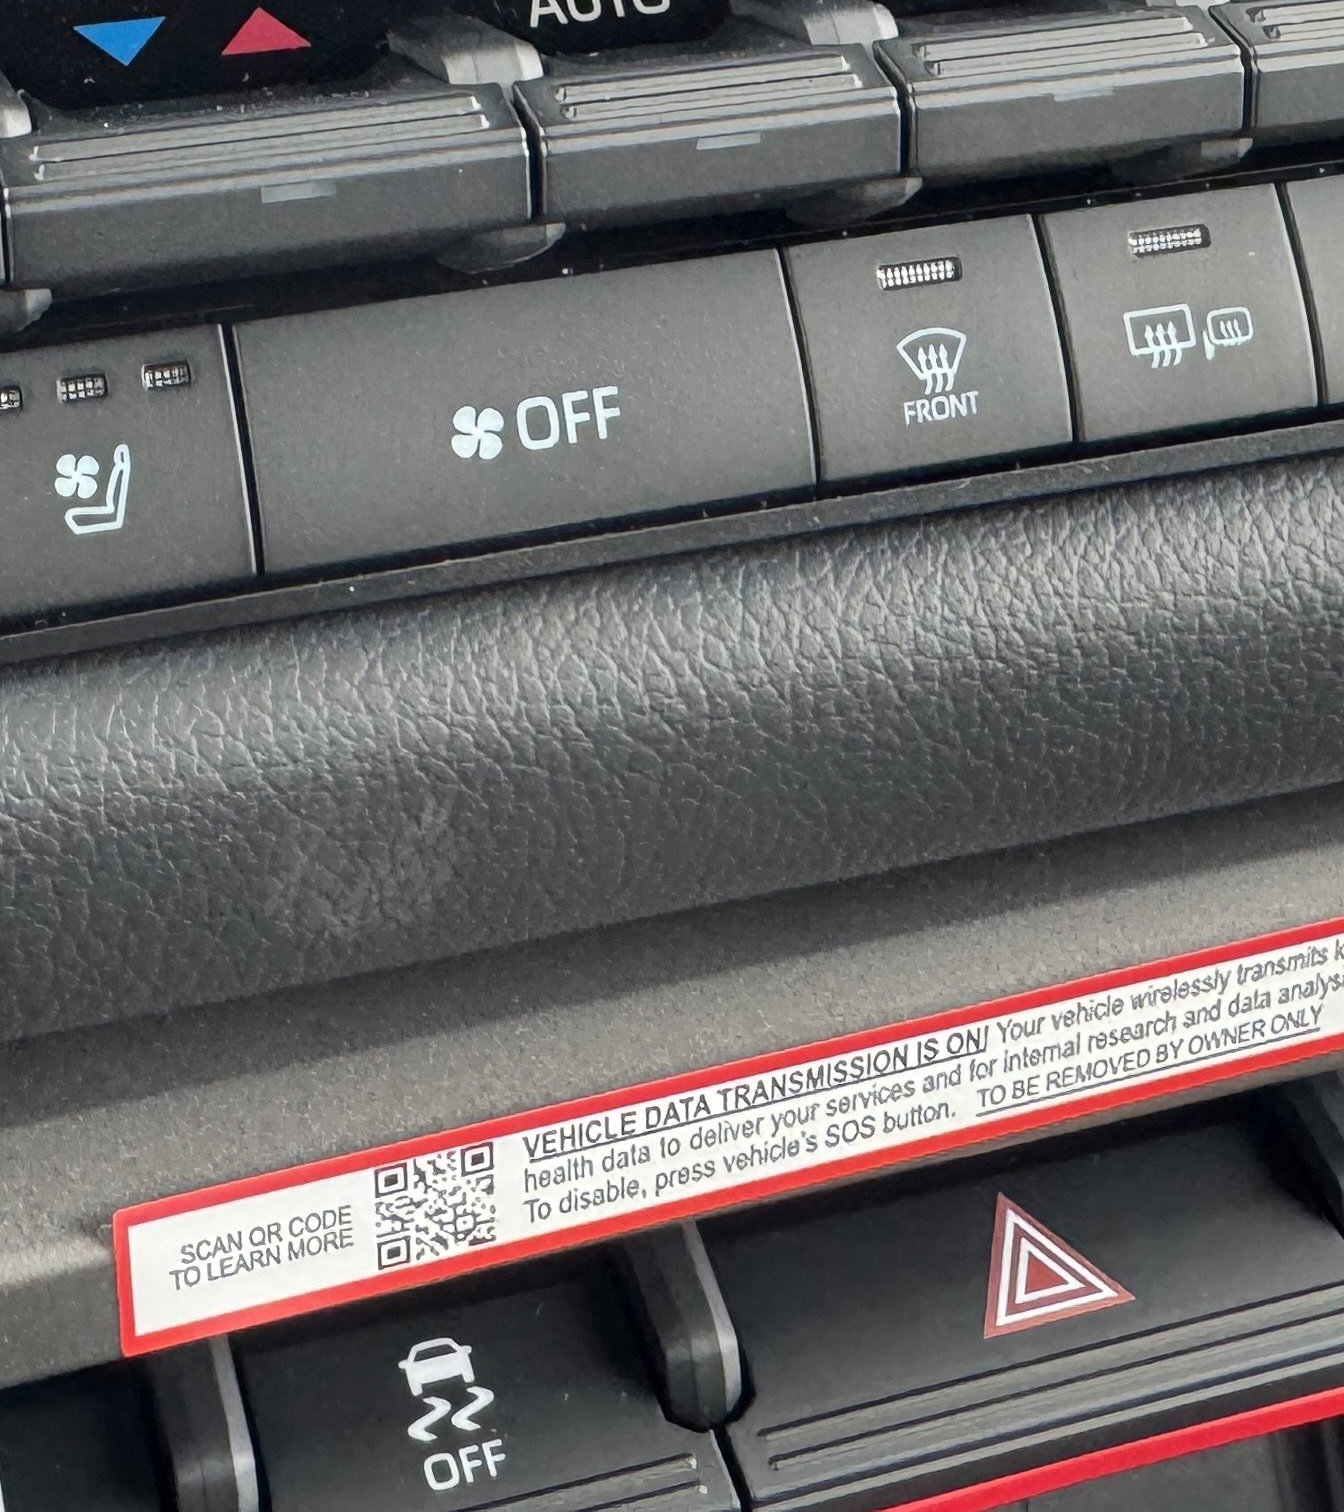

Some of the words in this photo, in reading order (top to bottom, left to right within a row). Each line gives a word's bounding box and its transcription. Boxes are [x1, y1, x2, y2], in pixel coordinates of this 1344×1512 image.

[515, 386, 621, 453] OFF
[903, 391, 980, 428] FRONT
[522, 1110, 636, 1160] VEHICLE
[645, 1094, 711, 1130] DATA
[717, 1045, 908, 1113] TRANSMISSION
[916, 1038, 940, 1063] IS
[946, 1026, 989, 1055] ON!
[997, 1016, 1046, 1046] Your
[1051, 994, 1125, 1032] vehicle
[1130, 968, 1231, 1010] wirelessly
[1237, 946, 1328, 985] transmits
[977, 1085, 1007, 1108] TO
[1011, 1073, 1039, 1100] BE
[1045, 1044, 1151, 1090] REMOVED
[1156, 1038, 1185, 1063] BY
[1187, 1019, 1265, 1056] OWNER
[1270, 1003, 1325, 1034] ONLY
[525, 1155, 594, 1193] health
[601, 1144, 651, 1174] data
[660, 1137, 681, 1160] to
[690, 1115, 765, 1152] deliver
[771, 1103, 820, 1136] your
[825, 1077, 915, 1118] services
[923, 1063, 962, 1095] and
[969, 1059, 995, 1083] for
[1003, 1033, 1081, 1073] internal
[1088, 1011, 1177, 1051] research
[1183, 999, 1221, 1028] and
[1228, 989, 1272, 1018] data
[523, 1198, 552, 1224] To
[558, 1178, 647, 1215] disable,
[655, 1159, 715, 1196] press
[722, 1131, 818, 1172] vehicle's
[825, 1115, 876, 1148] SOS
[883, 1101, 957, 1135] button.
[169, 1268, 200, 1291] TO
[207, 1245, 281, 1282] LEARN
[287, 1228, 354, 1261] MORE
[181, 1228, 242, 1264] SCAN
[249, 1221, 282, 1248] QR
[289, 1205, 352, 1239] CODE
[423, 1439, 507, 1492] OFF
